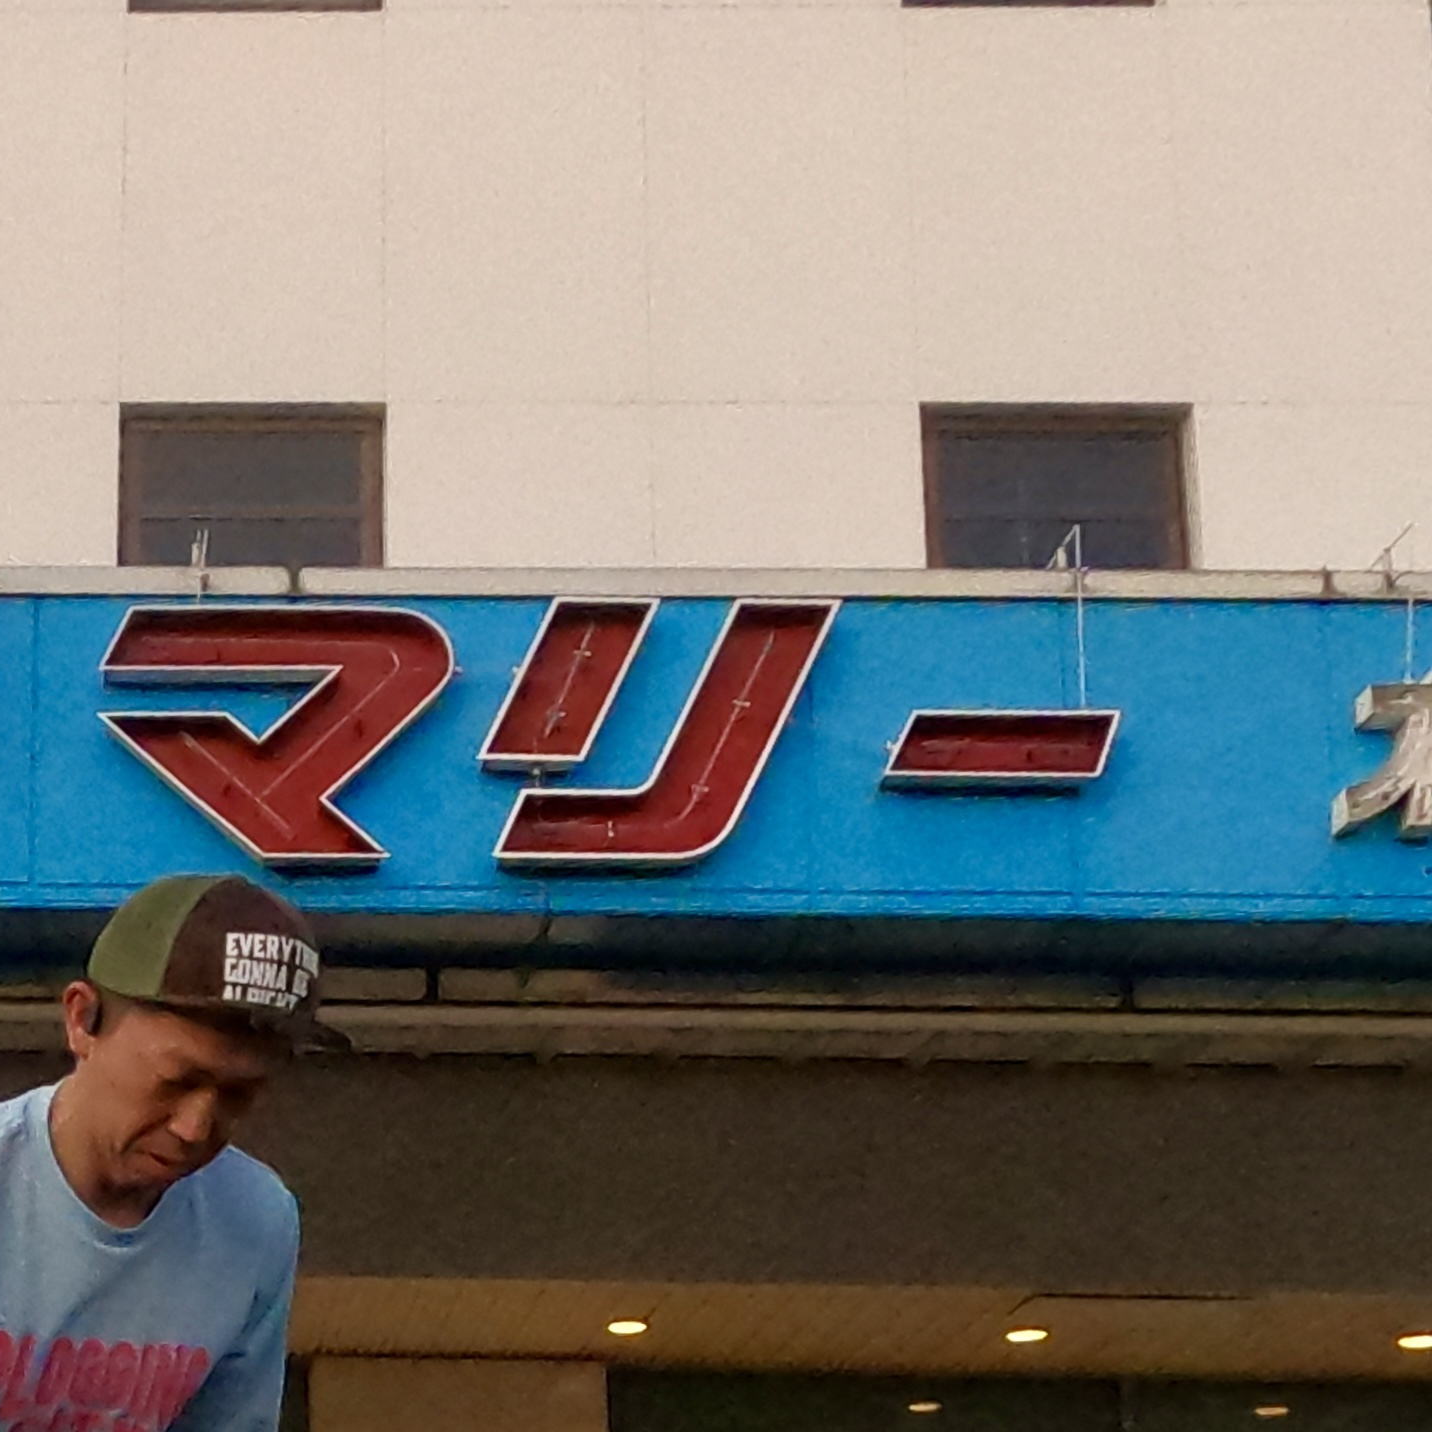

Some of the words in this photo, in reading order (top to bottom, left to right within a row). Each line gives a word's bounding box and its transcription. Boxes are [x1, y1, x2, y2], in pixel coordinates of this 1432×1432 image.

[98, 596, 1122, 868] マリー
[224, 957, 287, 991] GONNA
